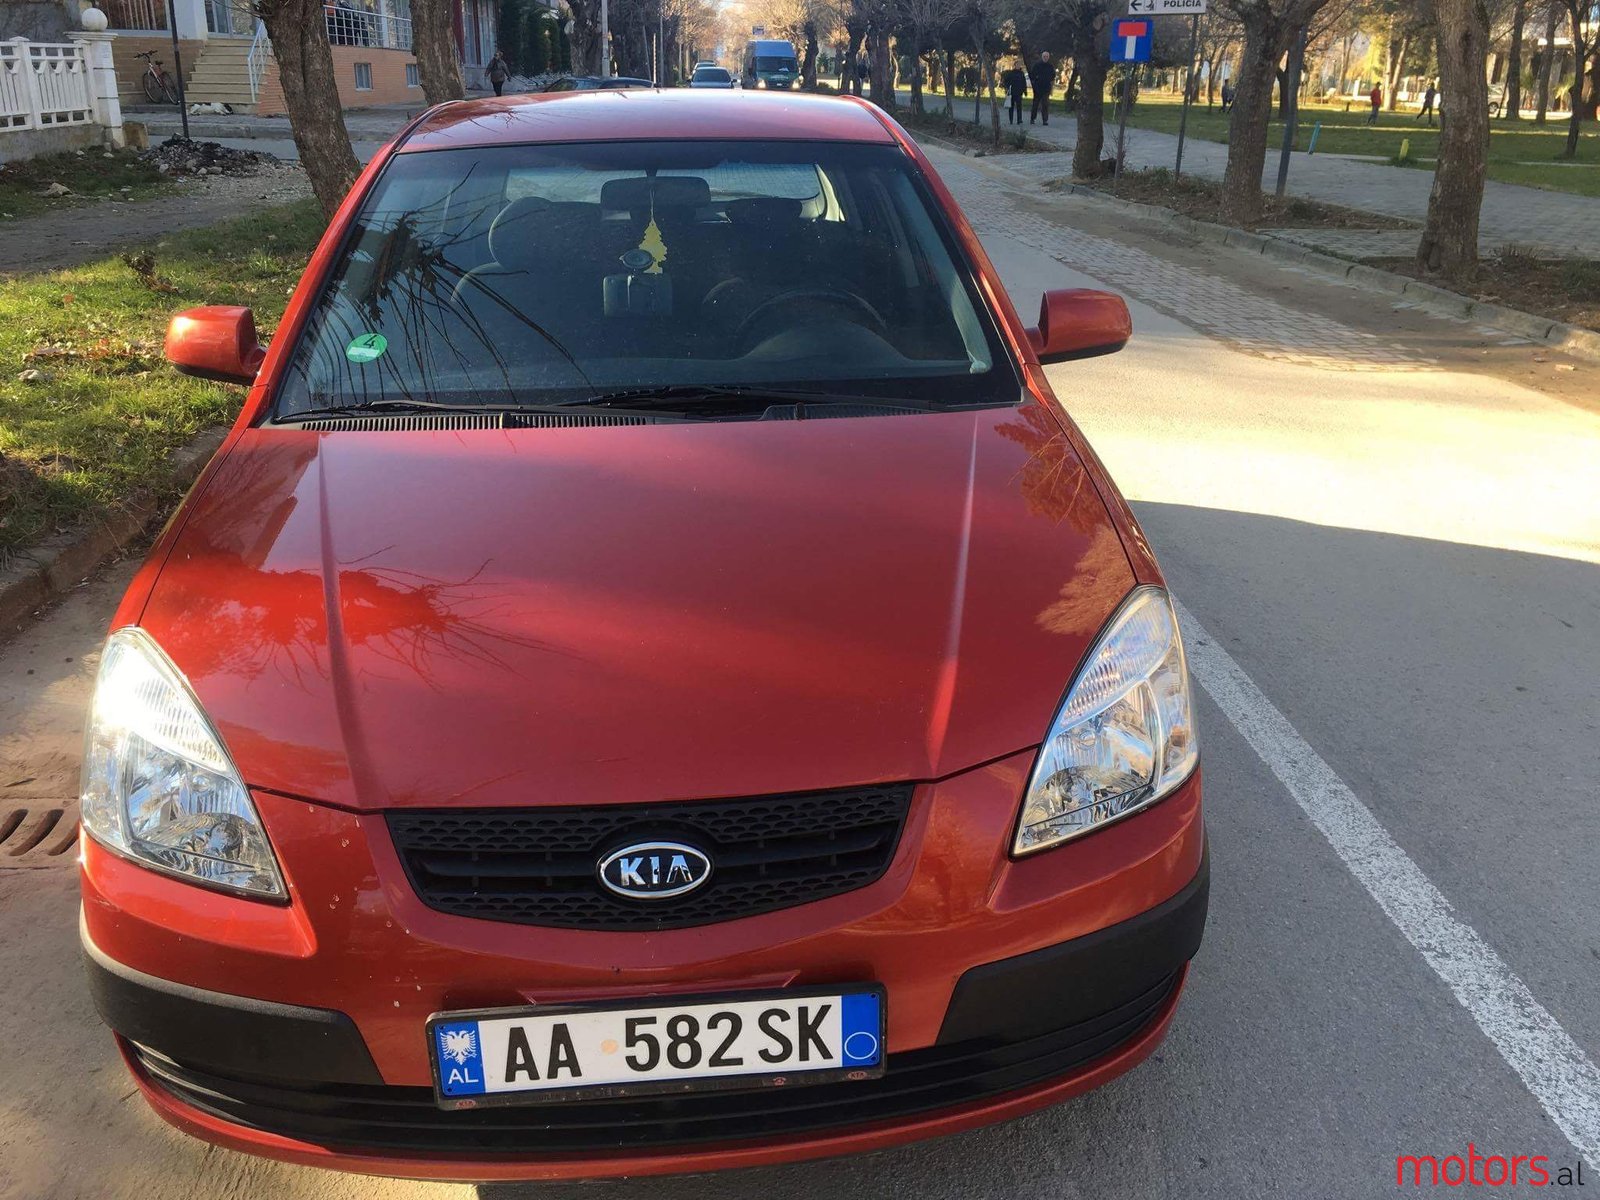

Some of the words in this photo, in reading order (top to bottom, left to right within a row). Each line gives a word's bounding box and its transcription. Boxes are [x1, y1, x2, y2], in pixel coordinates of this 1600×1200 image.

[619, 854, 693, 886] KIA
[504, 1023, 583, 1083] AA
[624, 1012, 744, 1072] 582
[757, 1004, 834, 1064] SK
[448, 1067, 479, 1085] AL
